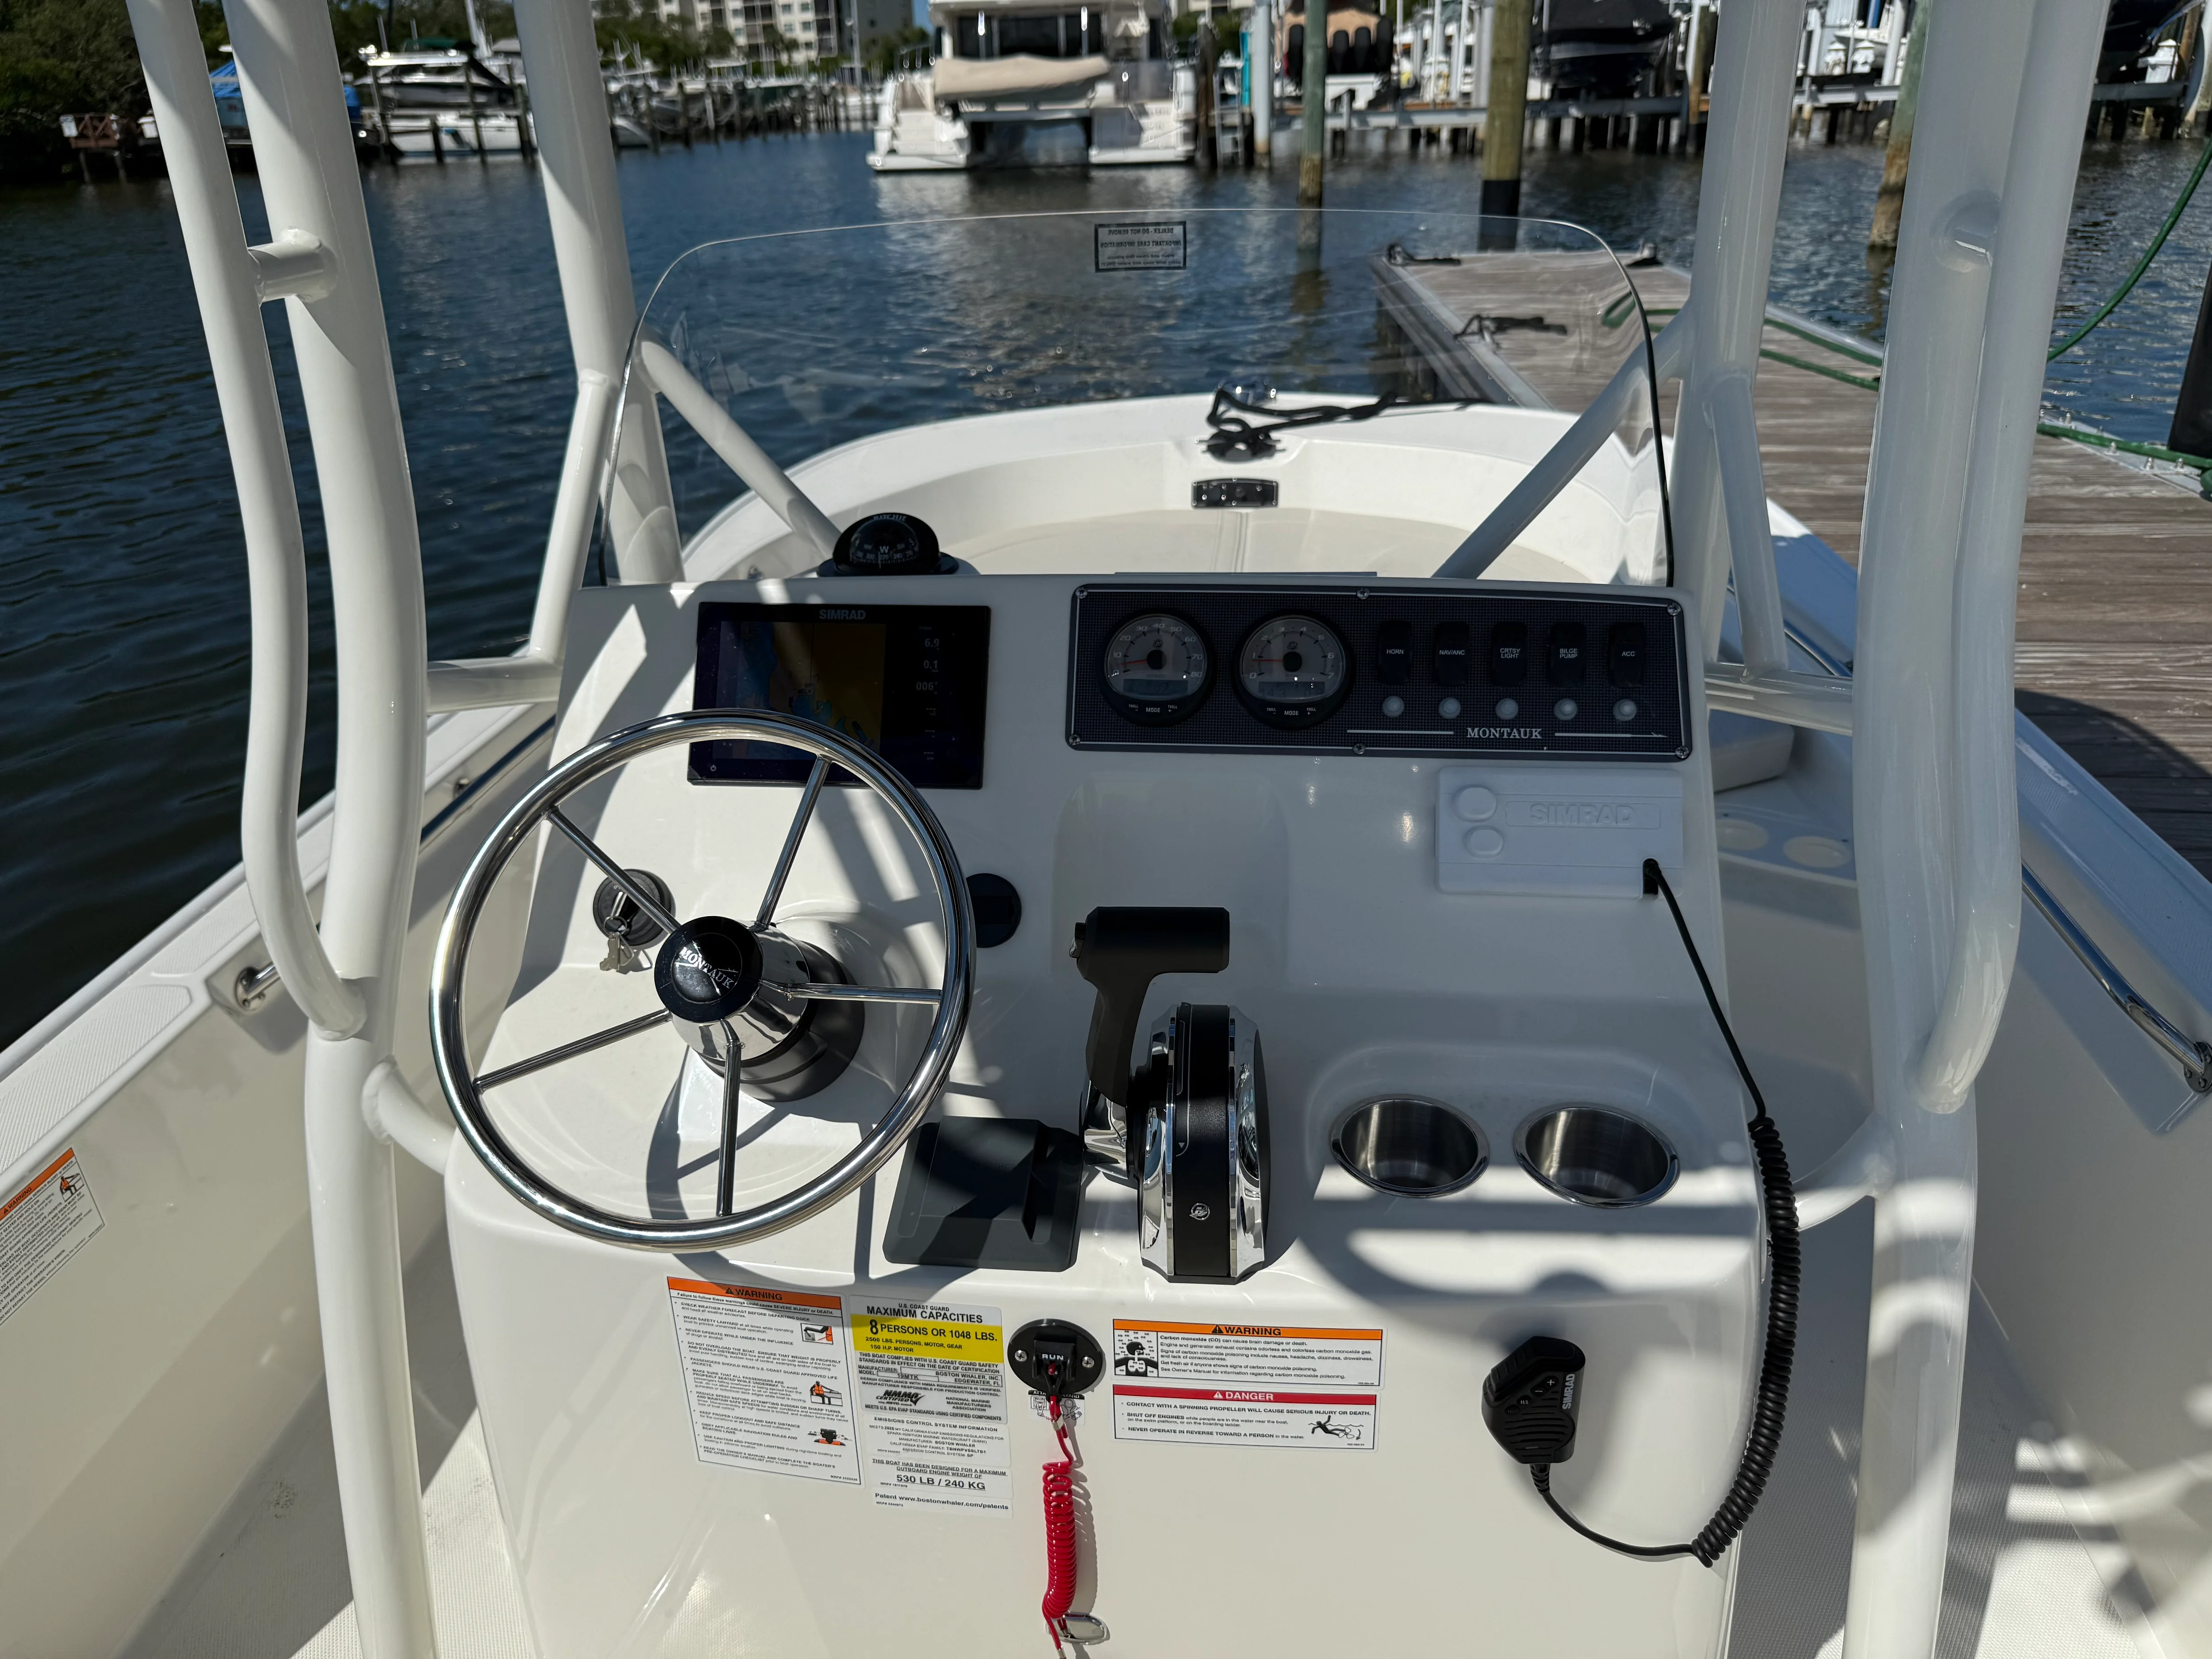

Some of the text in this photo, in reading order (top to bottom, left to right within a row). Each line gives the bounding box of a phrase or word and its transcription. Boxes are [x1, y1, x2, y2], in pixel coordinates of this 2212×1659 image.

[879, 545, 889, 553] W
[819, 609, 866, 620] SIMRAD
[925, 638, 940, 647] 6.9
[923, 660, 938, 669] 0.1
[1467, 728, 1542, 740] MONTAUK
[1529, 803, 1637, 826] SIMRAD
[680, 946, 734, 990] MONTAUK
[735, 1288, 783, 1301] WARNING
[867, 1306, 983, 1323] MAXIMUM CAPACITIES
[869, 1319, 997, 1341] 8 PERSONS OR 1048 LBS.
[1225, 1326, 1281, 1336] WARNING
[858, 1364, 899, 1373] MANUFACTURER:
[1226, 1391, 1273, 1400] DANGER
[1562, 1373, 1575, 1410] SIMRAD
[896, 1474, 916, 1483] 530
[919, 1476, 934, 1485] LB
[945, 1479, 964, 1488] 240
[968, 1481, 985, 1490] KG
[899, 1495, 1008, 1510] www.bostonwhaler.com/patents
